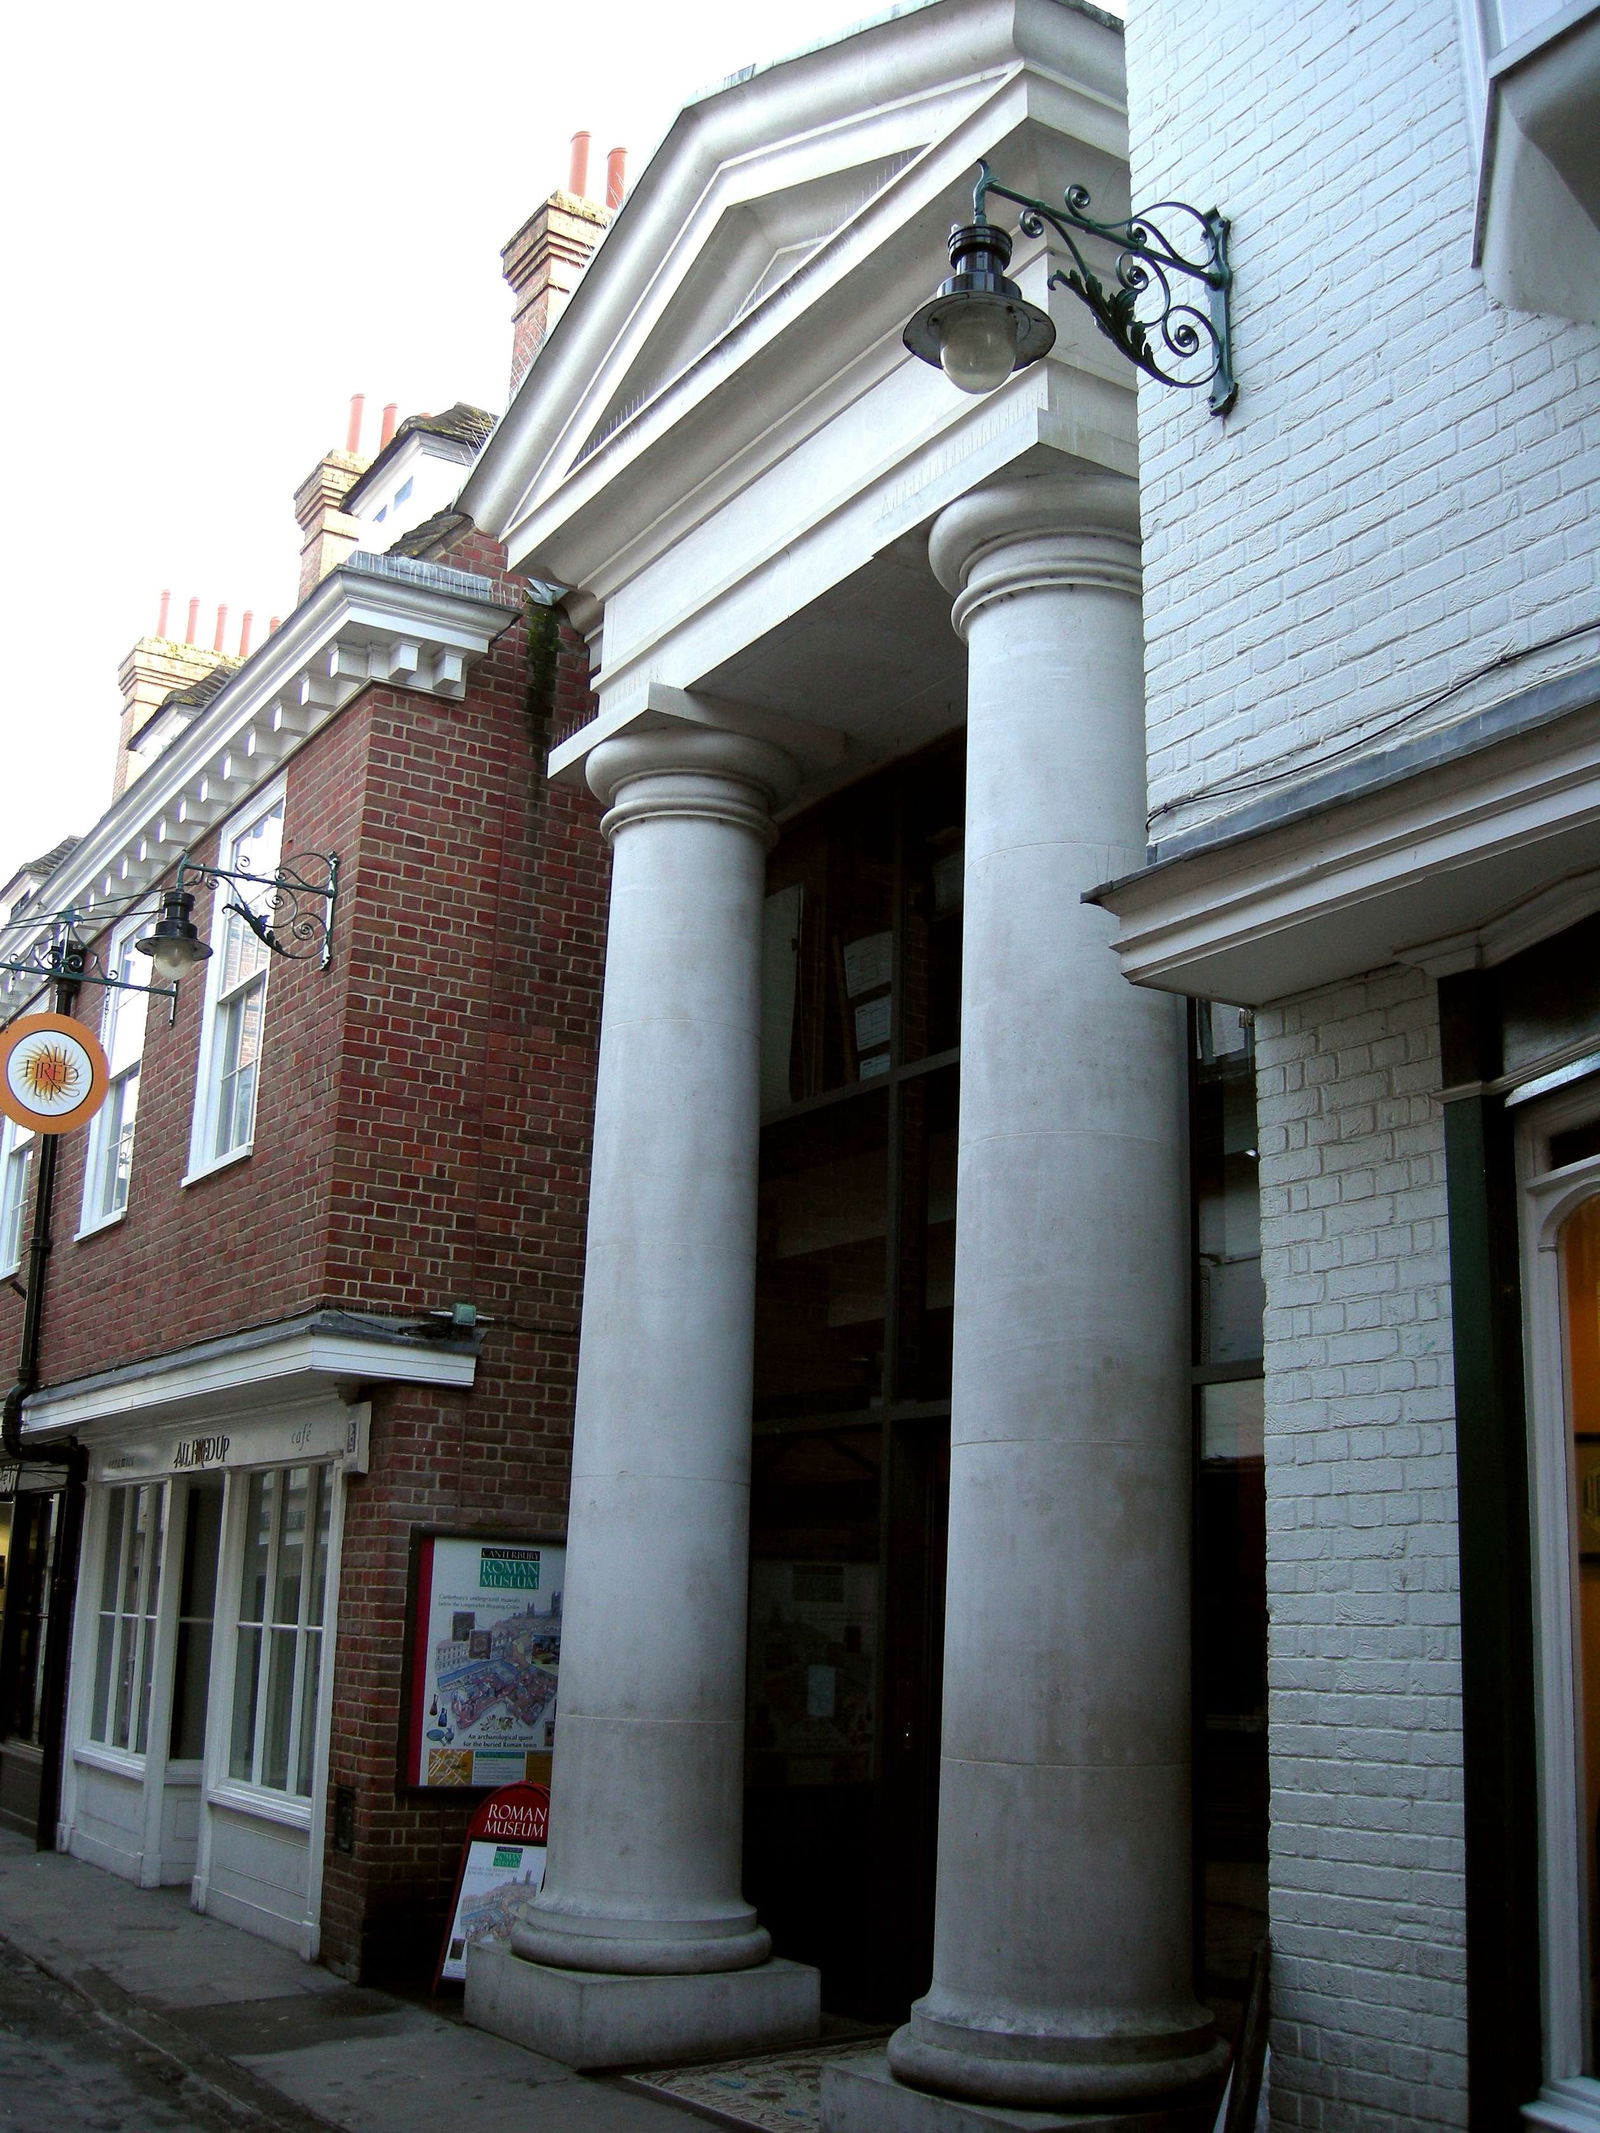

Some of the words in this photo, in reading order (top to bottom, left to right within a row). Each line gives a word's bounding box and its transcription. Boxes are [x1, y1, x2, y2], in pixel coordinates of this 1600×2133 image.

[40, 1044, 67, 1065] ALL
[25, 1060, 79, 1086] FIRED
[215, 1435, 230, 1463] UP
[482, 1550, 539, 1561] CANTERBURY
[482, 1561, 538, 1575] ROMAN
[481, 1575, 538, 1588] MUSEUM
[488, 1803, 548, 1822] ROMAN
[483, 1820, 544, 1837] MUSEUM
